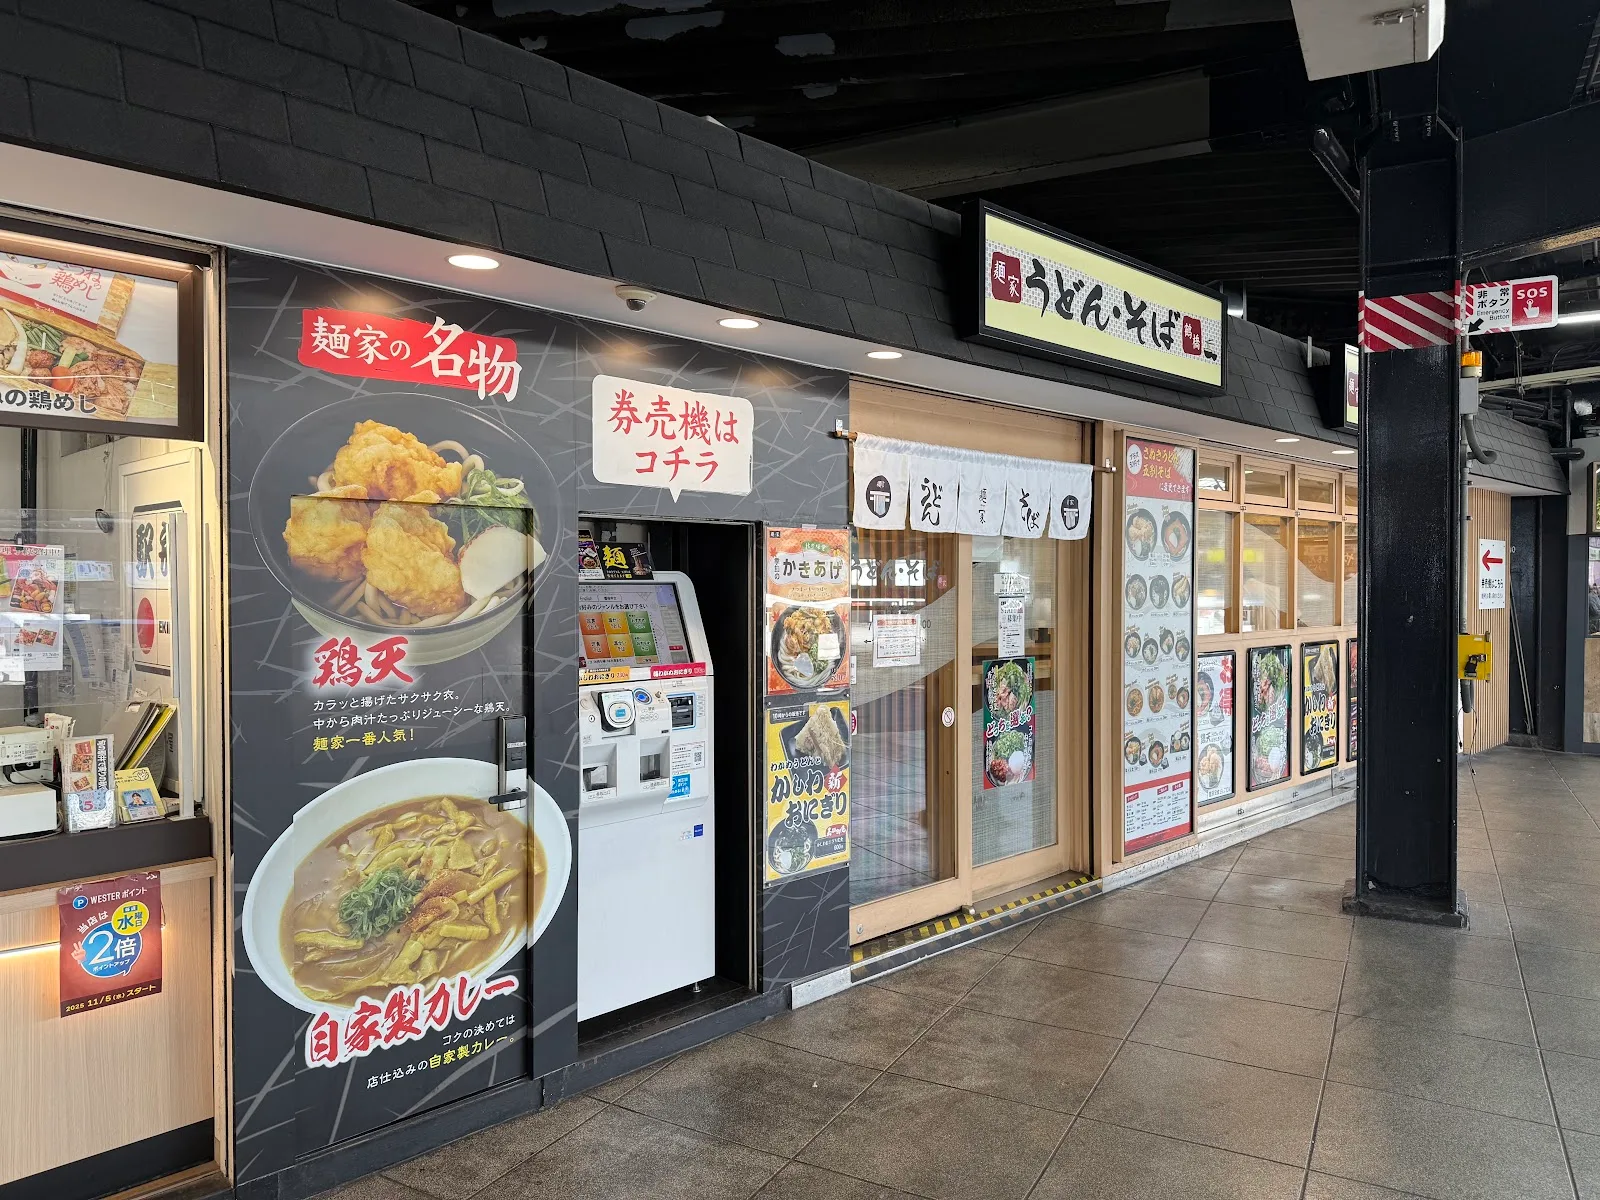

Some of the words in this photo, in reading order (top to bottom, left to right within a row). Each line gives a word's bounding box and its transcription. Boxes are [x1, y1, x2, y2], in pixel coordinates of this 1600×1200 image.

[994, 259, 1019, 298] 麺家
[1477, 287, 1510, 299] 非常
[1517, 286, 1548, 299] SOS
[1025, 258, 1181, 350] うどん・そば
[1476, 308, 1510, 316] Emergency
[1477, 298, 1510, 309] ボタン
[310, 316, 523, 402] 麺家の名物
[607, 388, 739, 446] 券売機は
[635, 445, 719, 483] コチラ
[1143, 446, 1179, 465] さぬきうどん
[920, 477, 944, 526] うどん
[783, 558, 844, 580] かきあげ
[312, 636, 414, 689] 鶏天
[312, 689, 460, 711] カラッと揚げたサクサク衣。
[312, 701, 511, 731] 中から肉汁たっぷりジューシーな鶏天。
[770, 768, 825, 804] かしわ
[827, 771, 843, 791] 新
[784, 791, 848, 829] おにぎり
[90, 891, 121, 904] WESTER
[121, 886, 148, 898] ポイント
[76, 910, 109, 934] 当店は
[88, 930, 137, 966] 2倍
[92, 958, 131, 972] ポイントアップ
[126, 984, 156, 998] スタート
[309, 976, 516, 1063] 自家製カレー
[442, 1014, 516, 1046] コクの決めては
